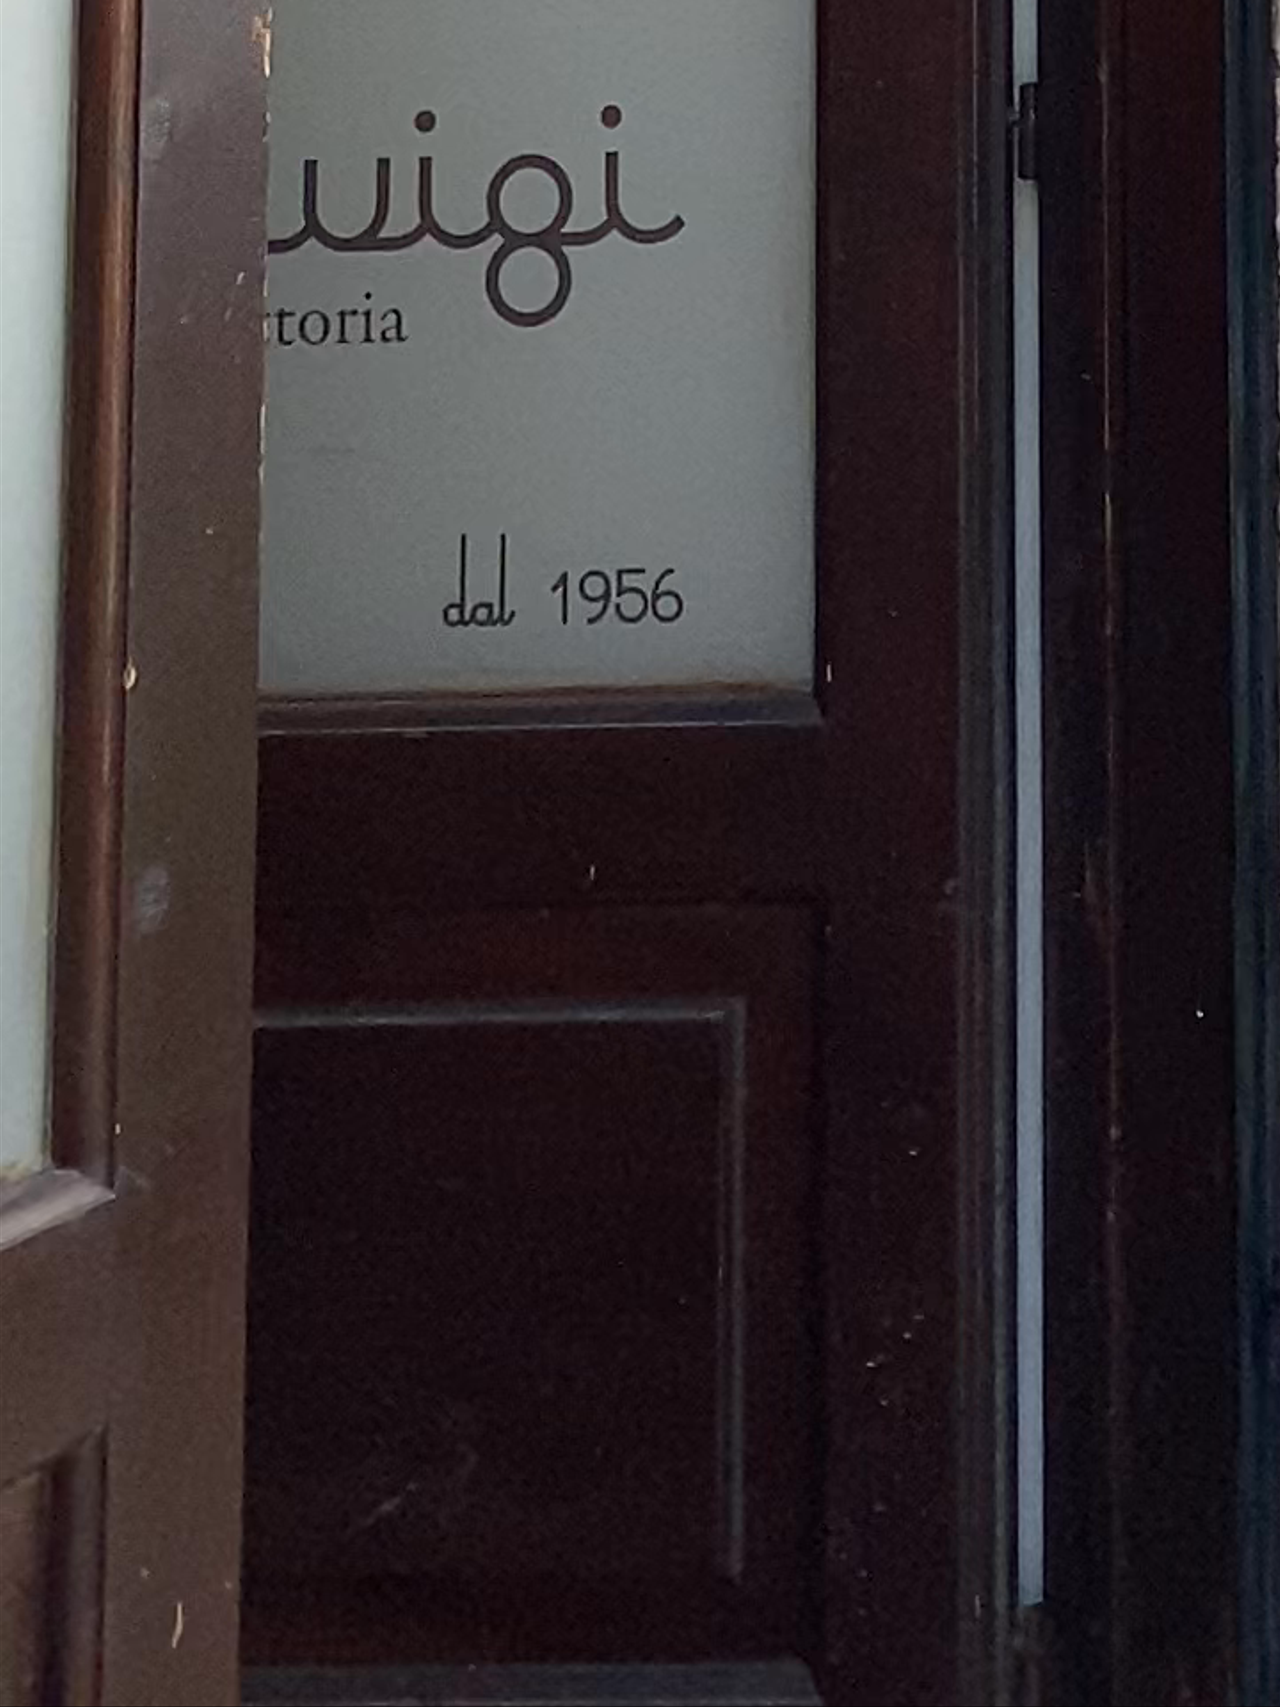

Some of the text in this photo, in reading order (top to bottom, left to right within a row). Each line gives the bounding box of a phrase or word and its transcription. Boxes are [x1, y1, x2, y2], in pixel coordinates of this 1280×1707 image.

[266, 103, 686, 329] uigi
[441, 532, 686, 628] dal 1956
